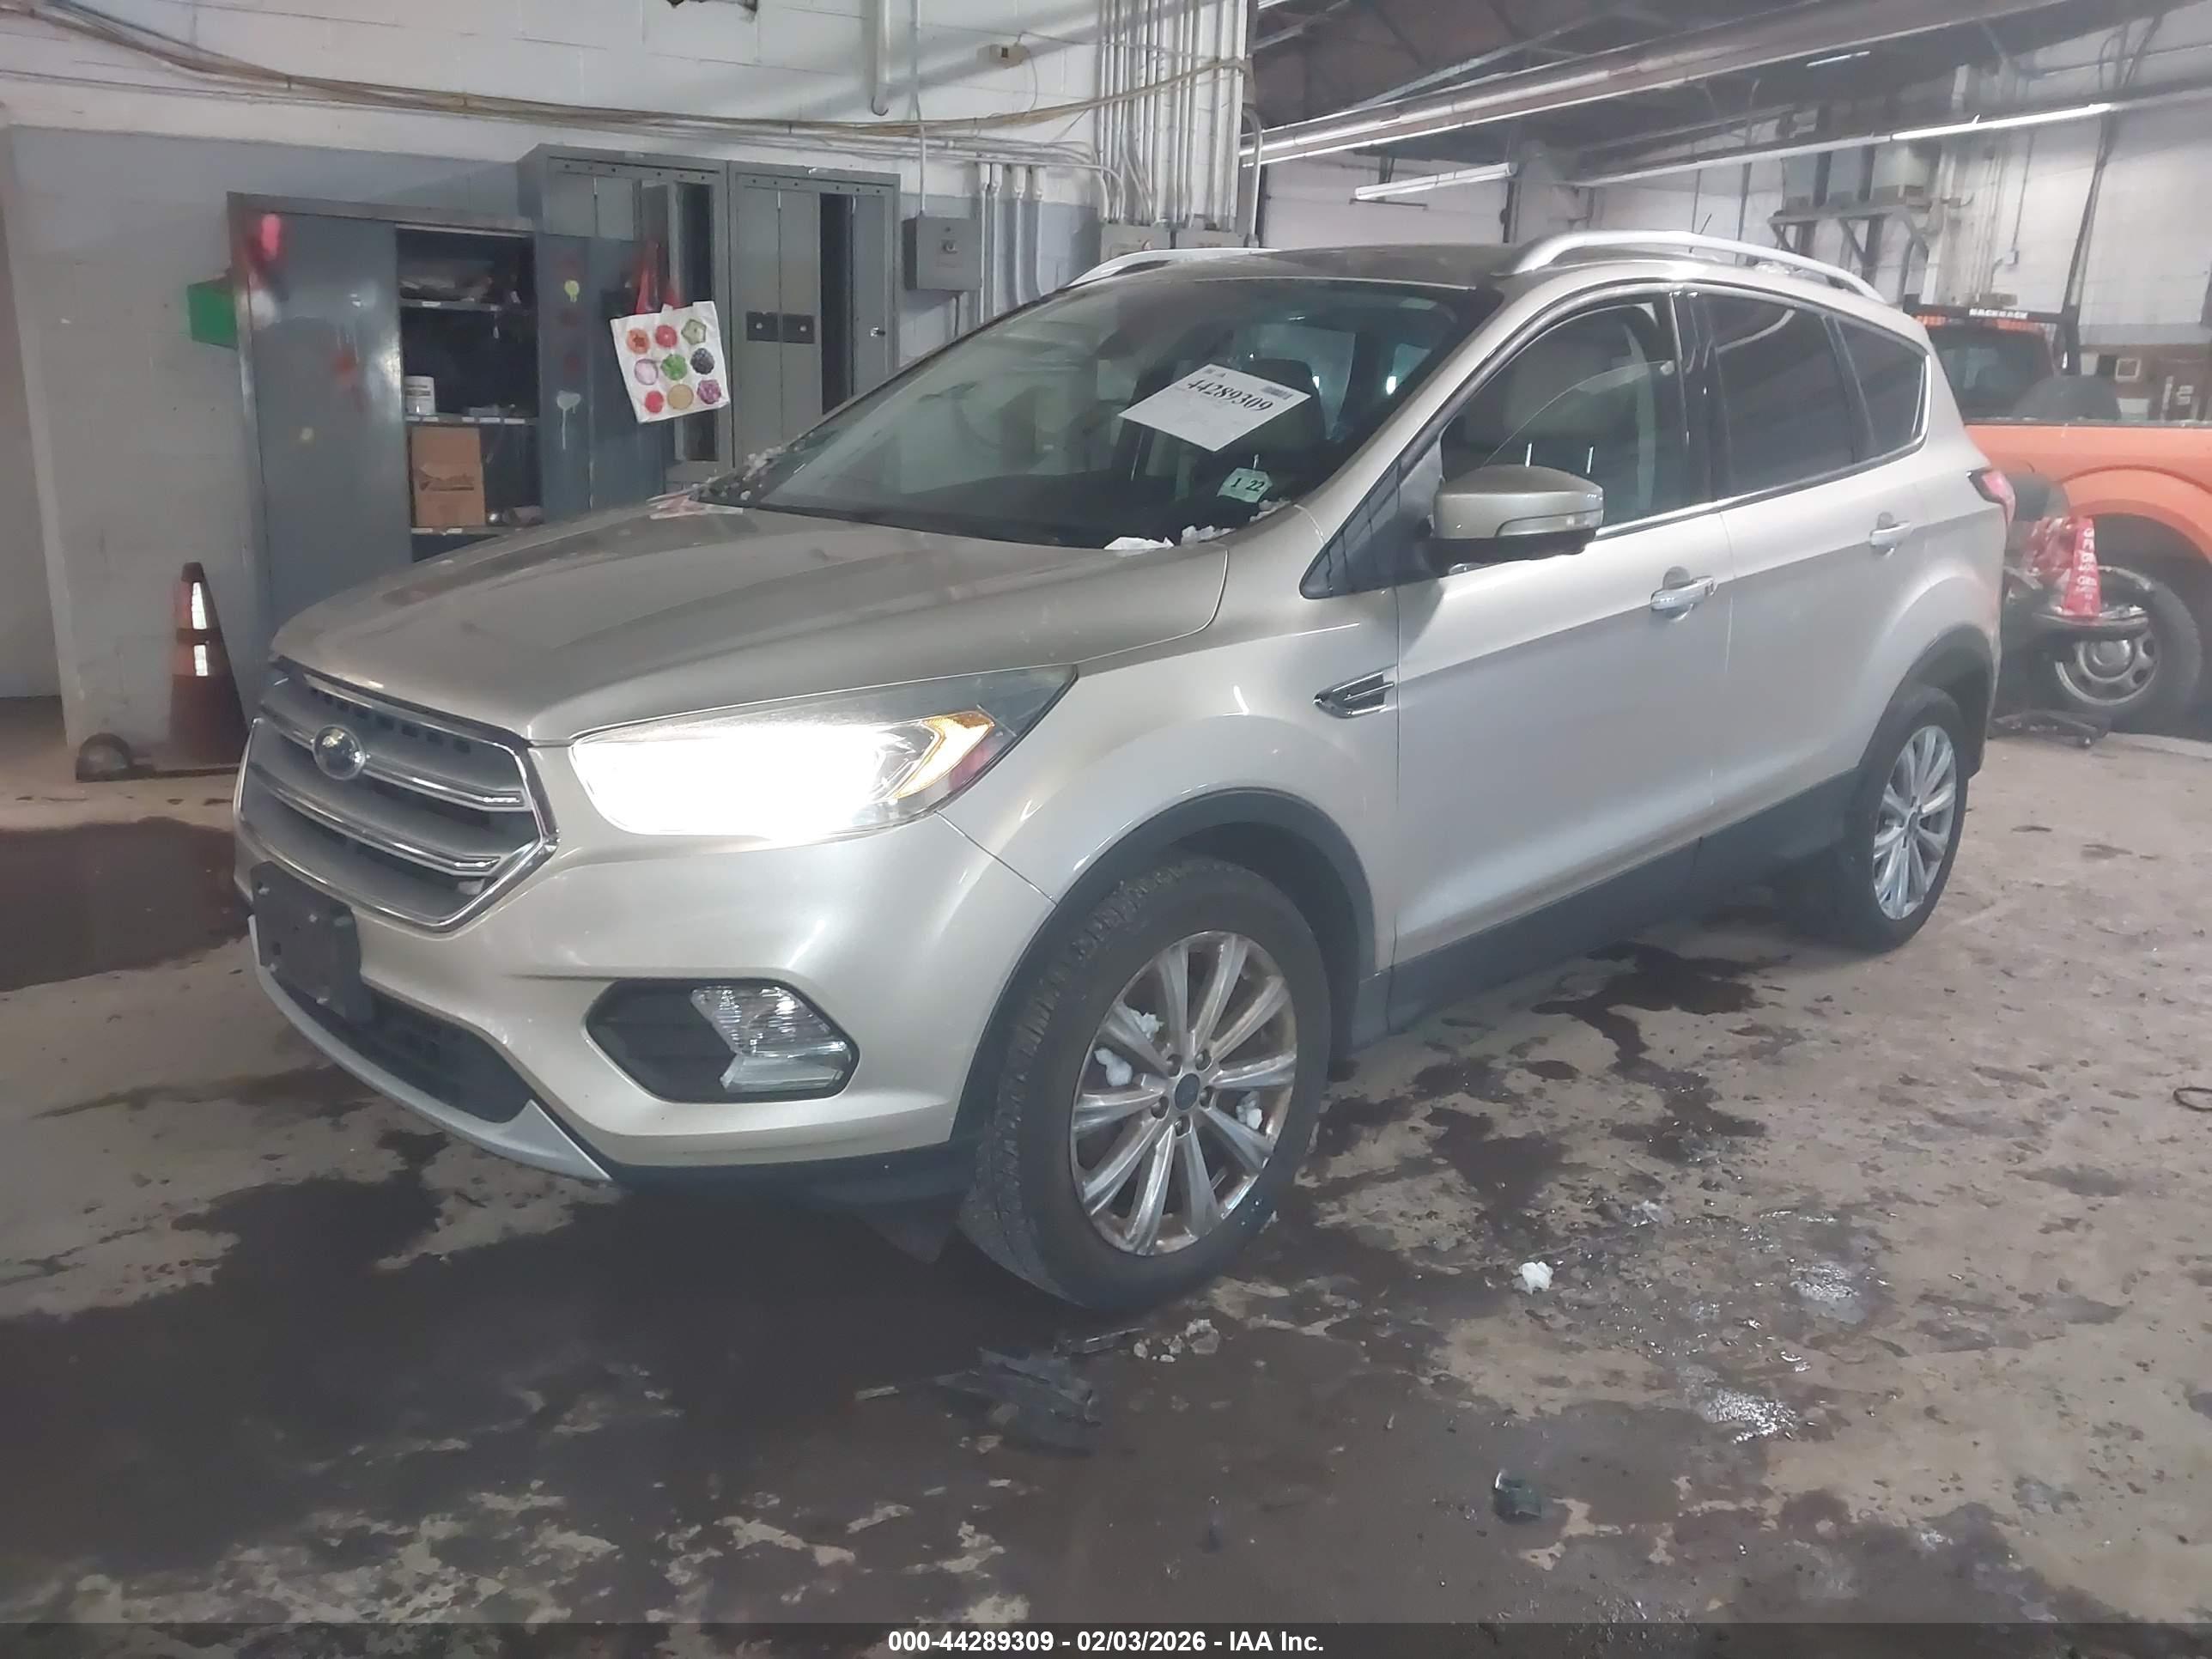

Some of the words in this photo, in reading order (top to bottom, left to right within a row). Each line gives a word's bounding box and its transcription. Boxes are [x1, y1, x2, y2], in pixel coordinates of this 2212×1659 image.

[1188, 379, 1273, 411] 44289309
[1231, 477, 1243, 488] 1
[1245, 479, 1265, 492] 22
